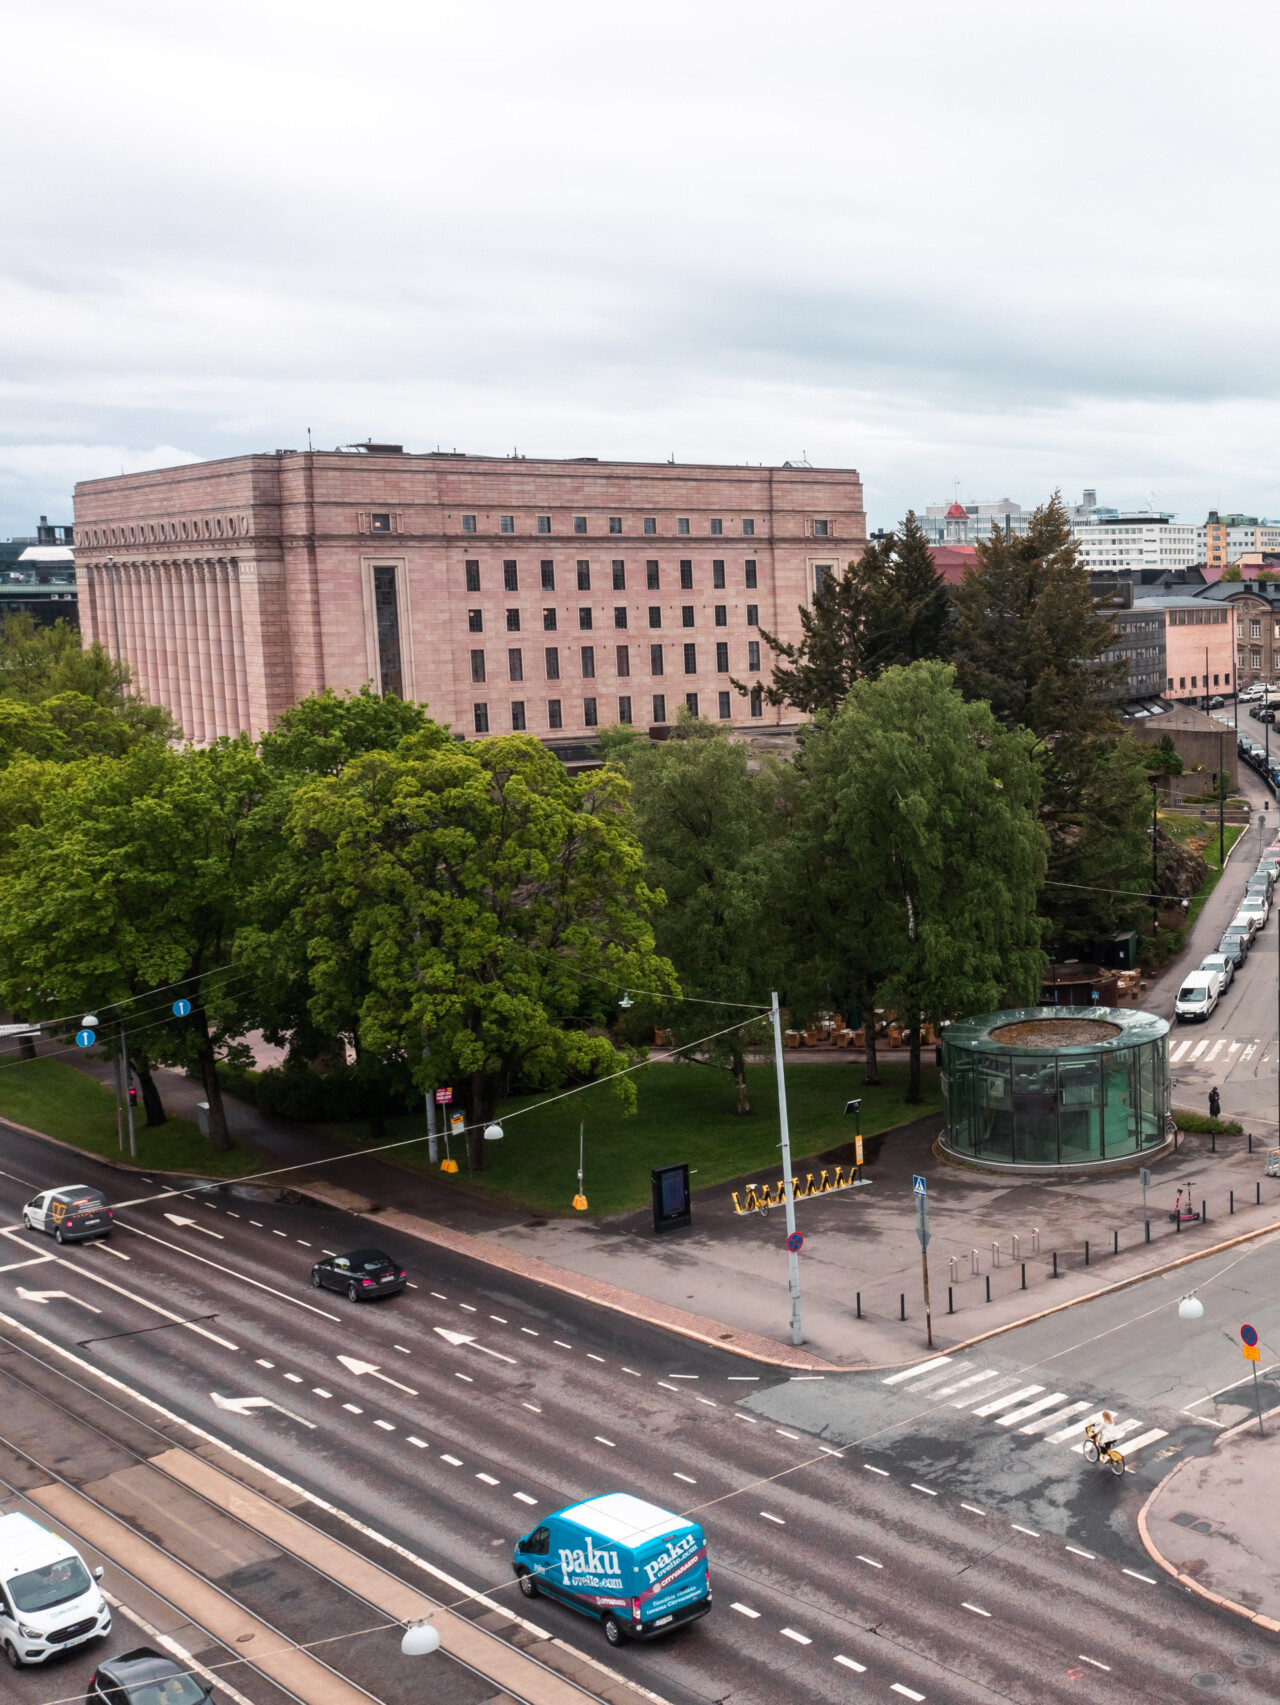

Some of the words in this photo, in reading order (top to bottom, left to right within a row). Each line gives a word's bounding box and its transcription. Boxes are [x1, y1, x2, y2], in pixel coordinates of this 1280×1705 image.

[558, 1537, 621, 1585] paku
[643, 1534, 696, 1584] paku
[657, 1545, 698, 1578] ovelle.com
[661, 1555, 699, 1587] CITYVARASTO
[572, 1575, 623, 1589] ovelle.com
